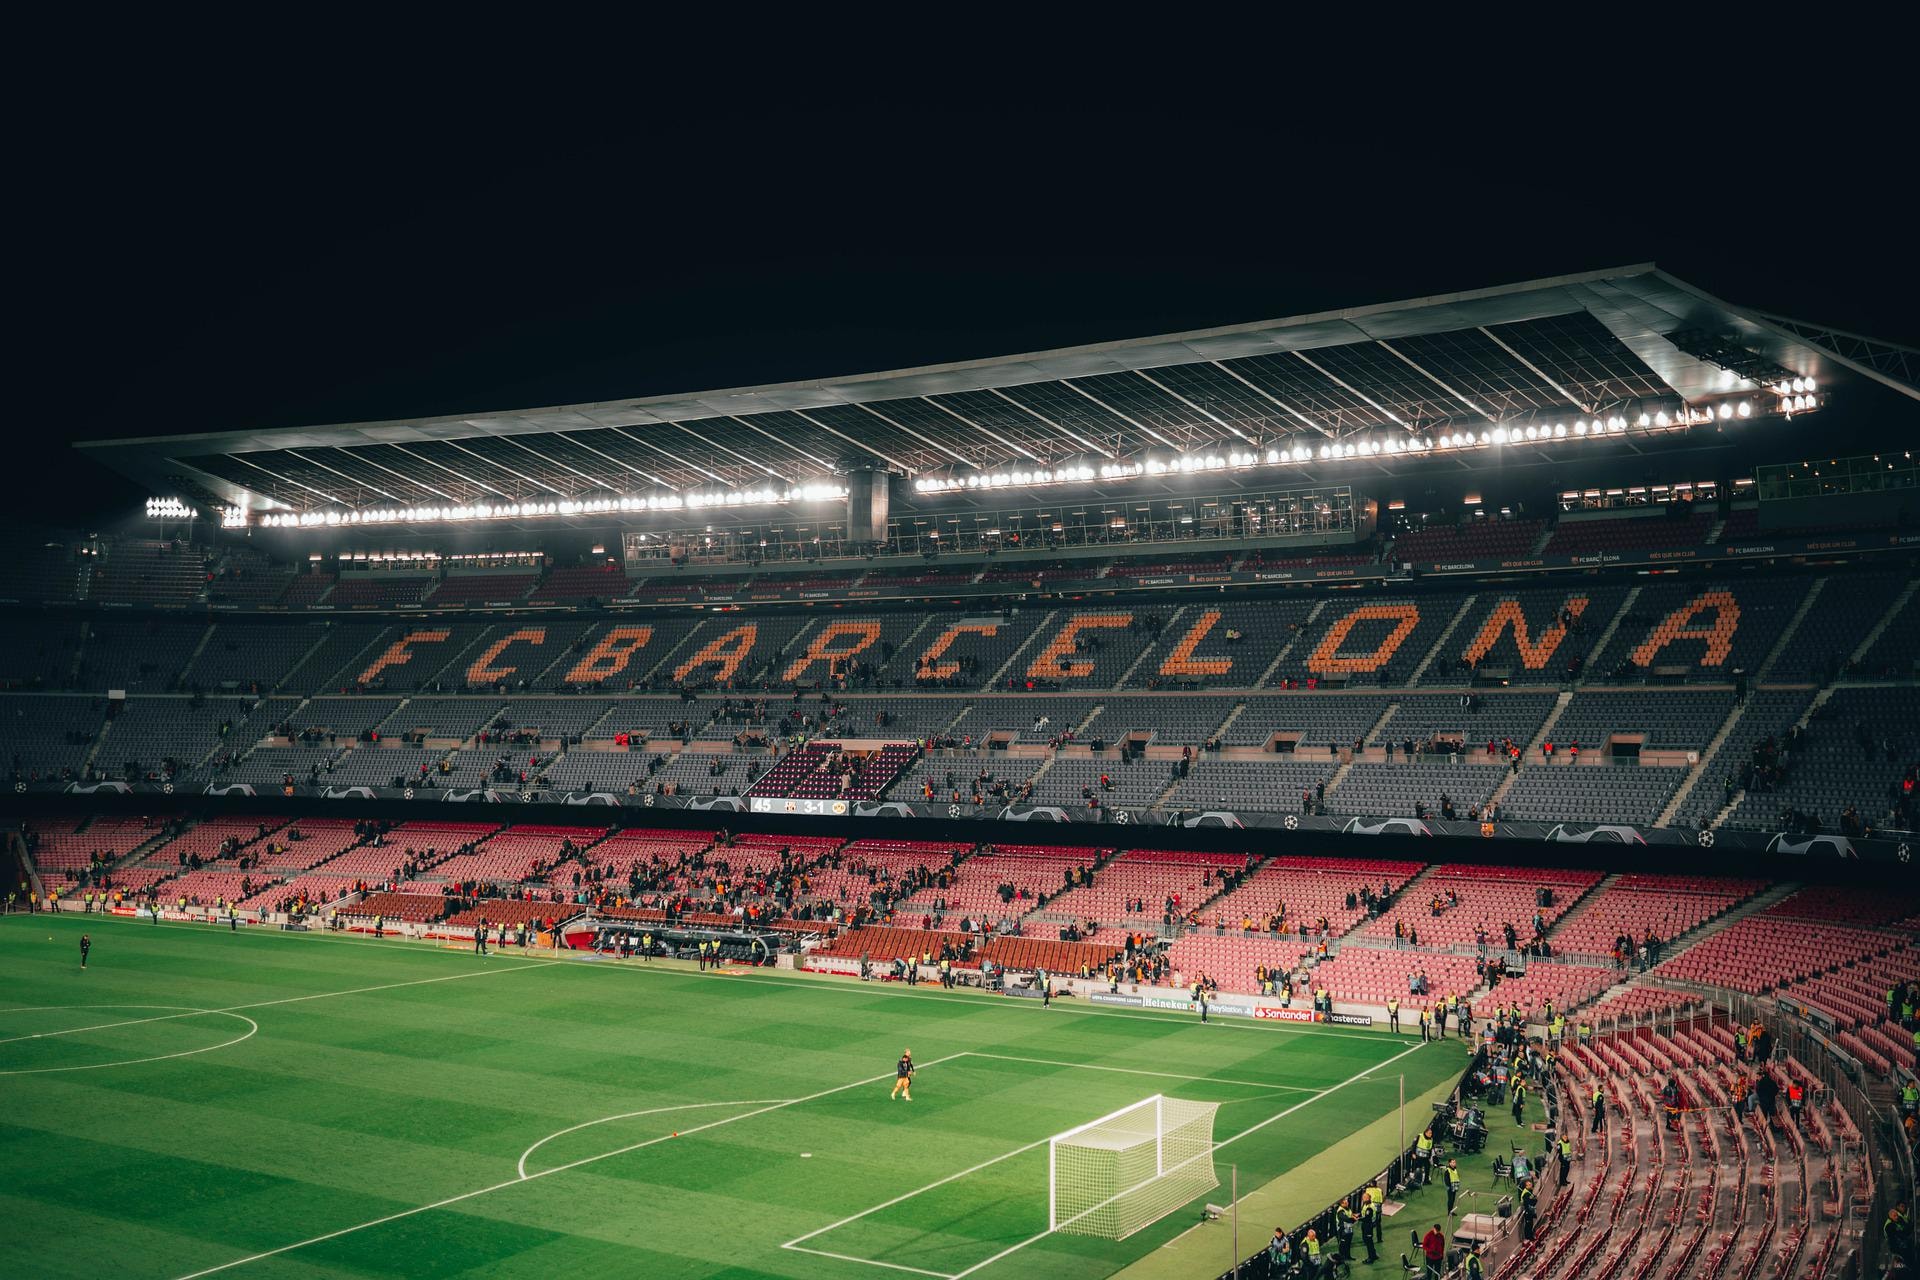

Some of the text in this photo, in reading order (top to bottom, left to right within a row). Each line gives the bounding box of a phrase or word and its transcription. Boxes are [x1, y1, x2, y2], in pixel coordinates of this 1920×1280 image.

[754, 799, 771, 811] 45
[804, 801, 824, 813] 3-1
[164, 912, 189, 920] NISSAN
[1145, 997, 1188, 1009] Heineken
[1209, 1004, 1242, 1014] PlayStation
[1265, 1008, 1310, 1021] Santander
